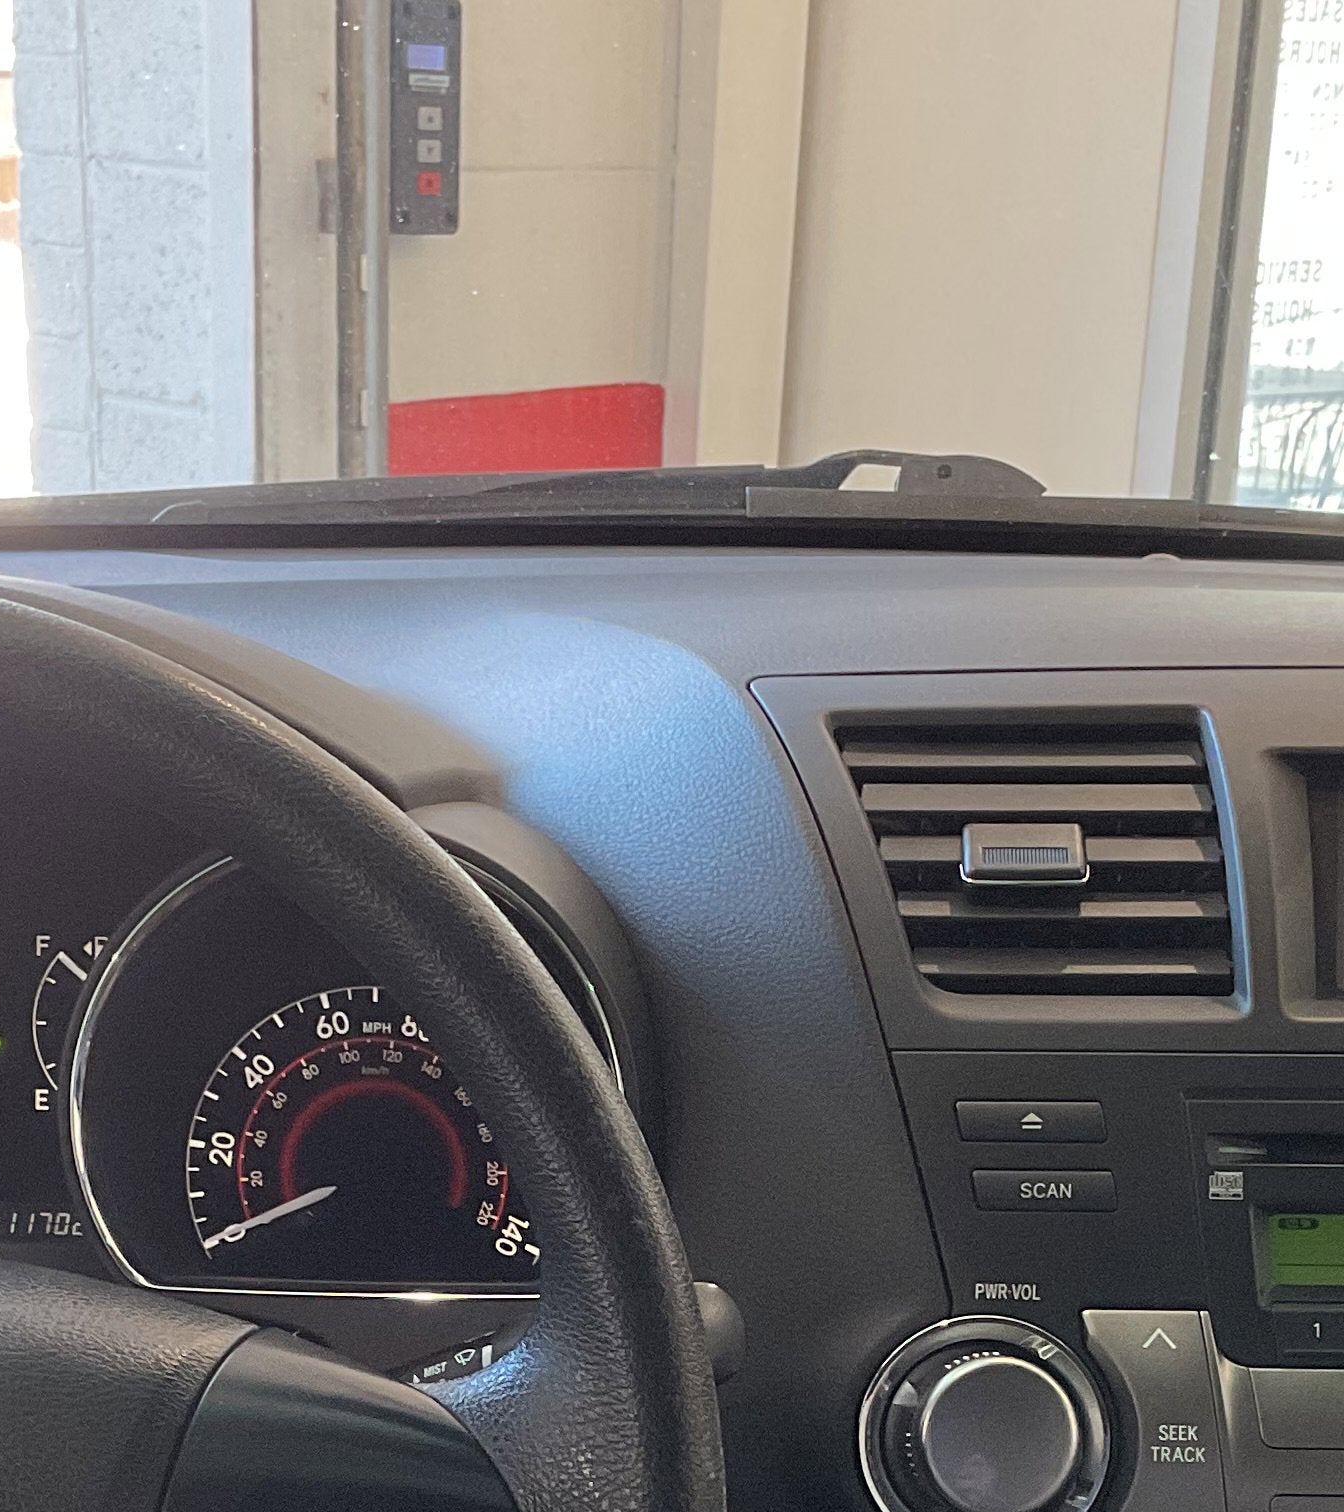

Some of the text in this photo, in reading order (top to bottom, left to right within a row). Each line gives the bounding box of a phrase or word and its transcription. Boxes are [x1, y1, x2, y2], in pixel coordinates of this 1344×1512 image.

[36, 935, 50, 956] F
[316, 1011, 349, 1039] 60
[363, 1022, 392, 1034] MPH
[338, 1050, 360, 1064] 100
[383, 1049, 403, 1063] 120
[244, 1054, 274, 1088] 40
[303, 1064, 319, 1080] 80
[421, 1061, 441, 1079] 140
[34, 1089, 49, 1110] E
[272, 1092, 288, 1109] 60
[254, 1130, 267, 1148] 40
[209, 1132, 235, 1167] 20
[251, 1171, 263, 1187] 20
[486, 1161, 498, 1186] 200
[1020, 1182, 1073, 1199] SCAN
[476, 1201, 494, 1226] 220
[495, 1215, 530, 1256] 140
[1312, 1323, 1321, 1339] 1
[423, 1361, 448, 1378] MIST
[1158, 1425, 1198, 1441] SEEK
[1151, 1446, 1205, 1463] TRACK
